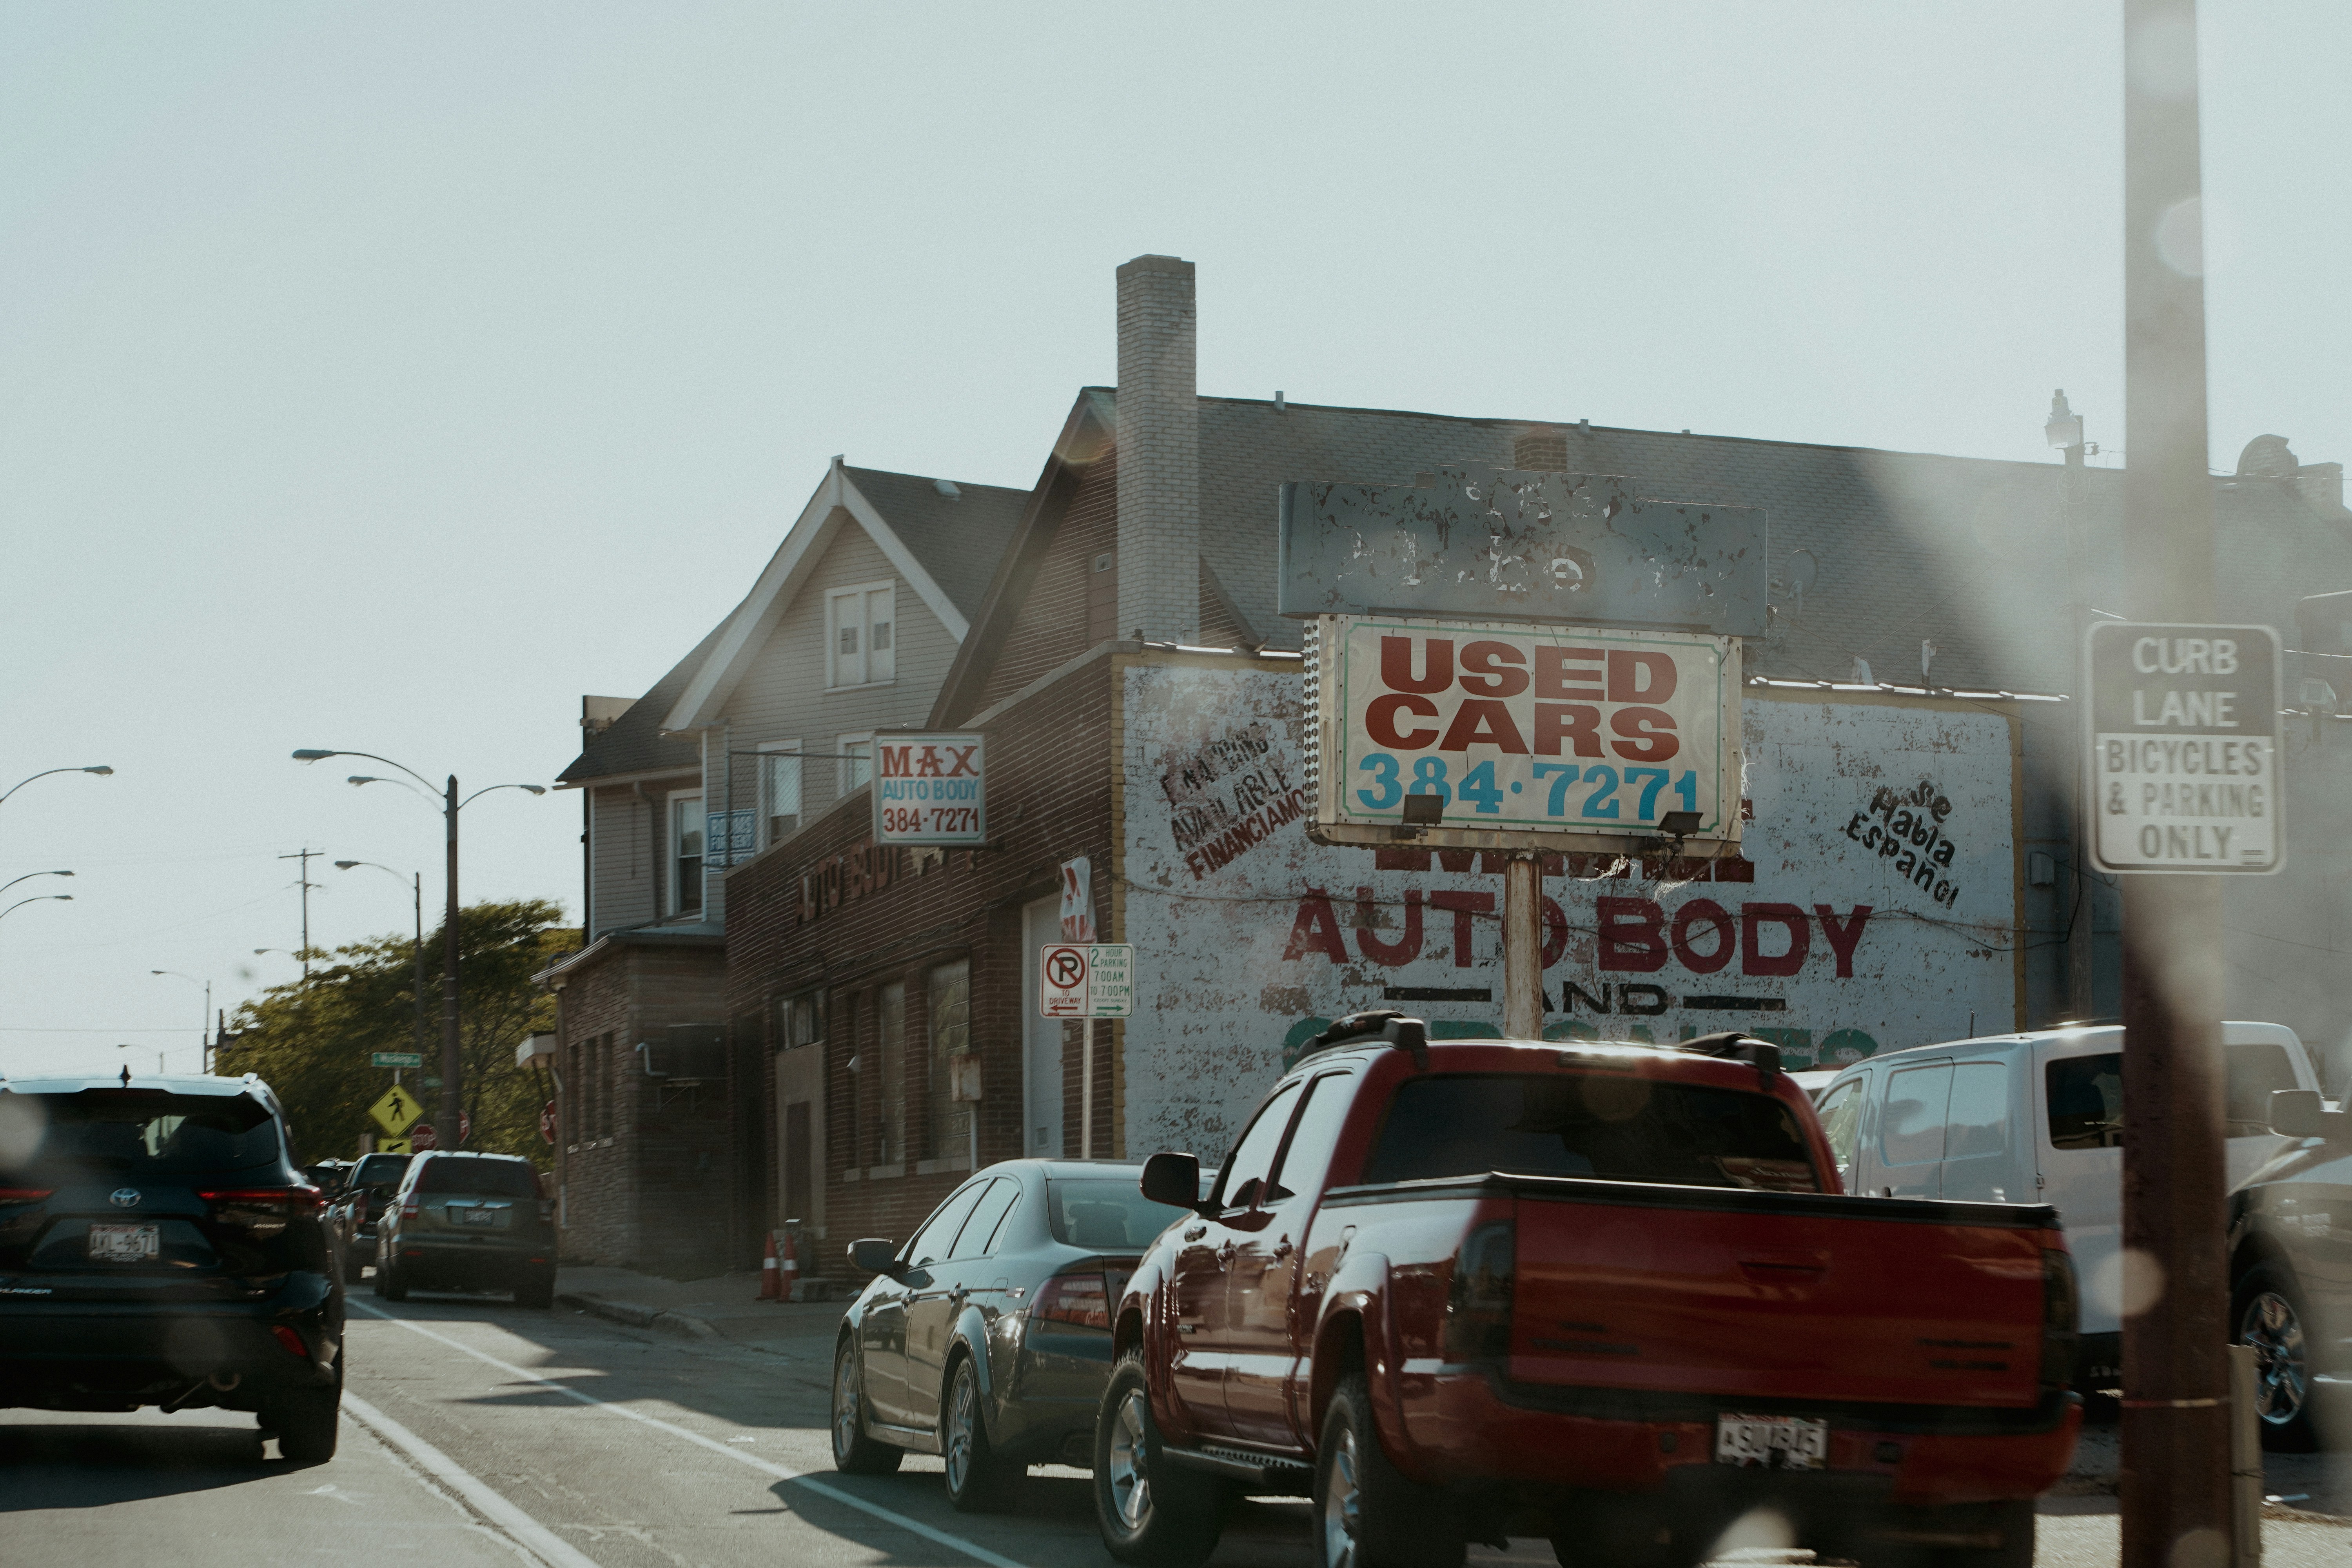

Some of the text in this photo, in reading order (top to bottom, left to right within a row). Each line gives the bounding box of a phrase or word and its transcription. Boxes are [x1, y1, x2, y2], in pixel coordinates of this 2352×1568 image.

[1381, 636, 1677, 704] USED
[2132, 637, 2239, 674] CURB
[2133, 690, 2239, 727] LANE
[1365, 693, 1680, 762] CARS
[880, 746, 979, 777] MAX
[2107, 739, 2261, 776] BICYCLES
[882, 779, 979, 800] AUTO BODY
[1910, 780, 1952, 824] Se
[2107, 781, 2264, 818] & PARKING
[1185, 785, 1304, 881] FINANCIAMO
[1869, 785, 1955, 868] Habla
[2139, 824, 2234, 859] ONLY
[1846, 809, 1959, 910] Español
[1595, 896, 1873, 978] BODY
[1091, 948, 1123, 967] 2 HOUR
[1100, 958, 1127, 967] PARKING
[1090, 986, 1097, 995] TO
[1542, 981, 1669, 1016] ND
[412, 1134, 436, 1146] STOP
